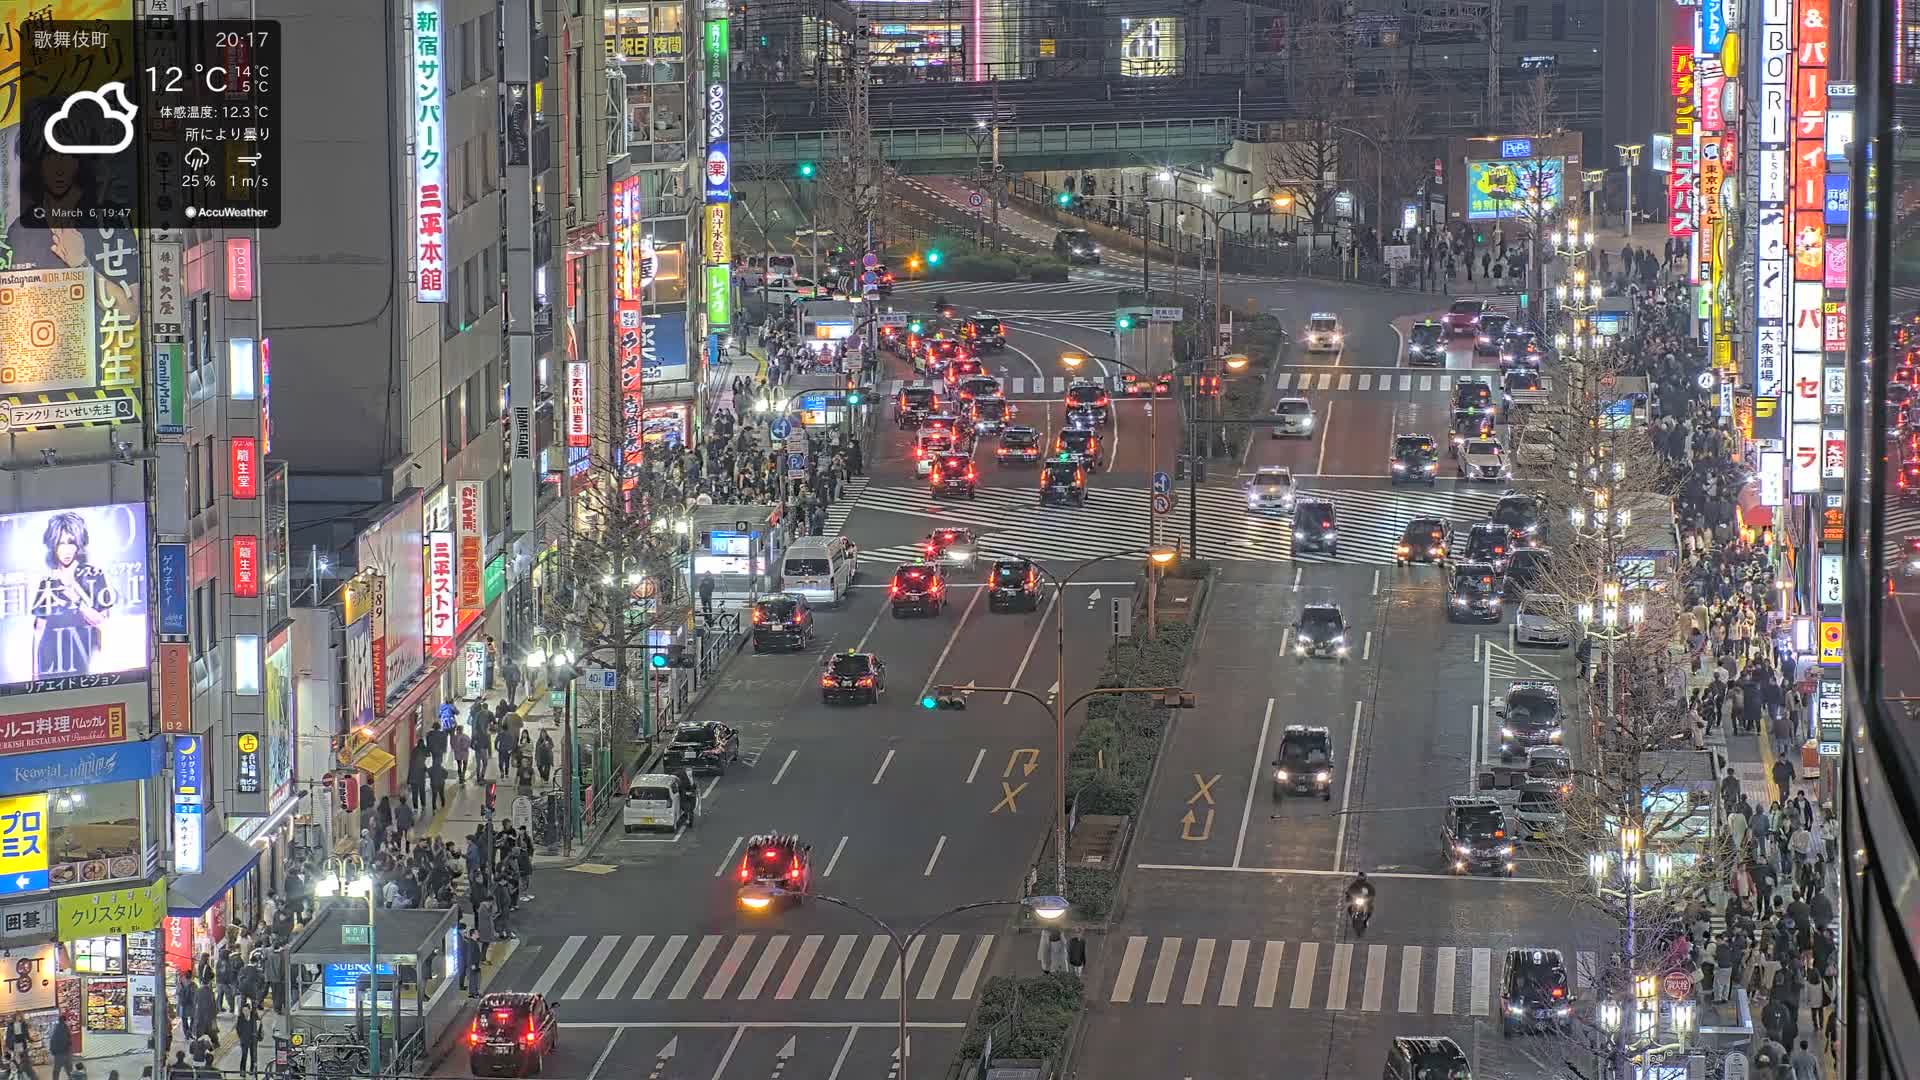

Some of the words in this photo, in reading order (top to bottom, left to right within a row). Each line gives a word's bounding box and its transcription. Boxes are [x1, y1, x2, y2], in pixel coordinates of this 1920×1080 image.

[620, 37, 648, 55] 祝日
[416, 11, 440, 169] 新宿サンパーク
[1676, 54, 1694, 135] パチンコ
[710, 86, 724, 136] もつなべ
[1707, 88, 1719, 119] アコム
[1799, 9, 1827, 204] &パーティー
[708, 160, 726, 177] 薬
[1674, 146, 1693, 231] エスパス
[420, 184, 442, 291] 三平本館
[711, 275, 724, 313] レイク
[159, 325, 177, 333] 3F
[622, 331, 640, 388] ラーメン
[1760, 330, 1774, 382] 大衆酒場
[159, 353, 170, 415] FamilyMart
[1795, 309, 1821, 468] パセラ
[14, 409, 50, 421] テンクリ
[55, 404, 113, 418] たいせい先生
[1830, 405, 1843, 415] 5F
[462, 486, 473, 531] GAME
[1829, 496, 1840, 506] 3F
[161, 554, 176, 606] ゲウチャイ
[433, 543, 451, 629] 三平ストア
[25, 677, 75, 693] リアエイト
[80, 674, 121, 689] ビジョン
[0, 715, 70, 739] ルコ料理
[111, 711, 120, 735] 5F
[26, 735, 71, 747] RESTAURANT
[243, 734, 256, 751] 占
[182, 805, 194, 814] 2F
[1, 811, 41, 834] プロ
[2, 835, 41, 858] ミス
[6, 911, 40, 931] 囲碁
[71, 903, 143, 927] クリスタル
[333, 963, 385, 972] SUBNAE
[1667, 978, 1688, 990] 消火栓
